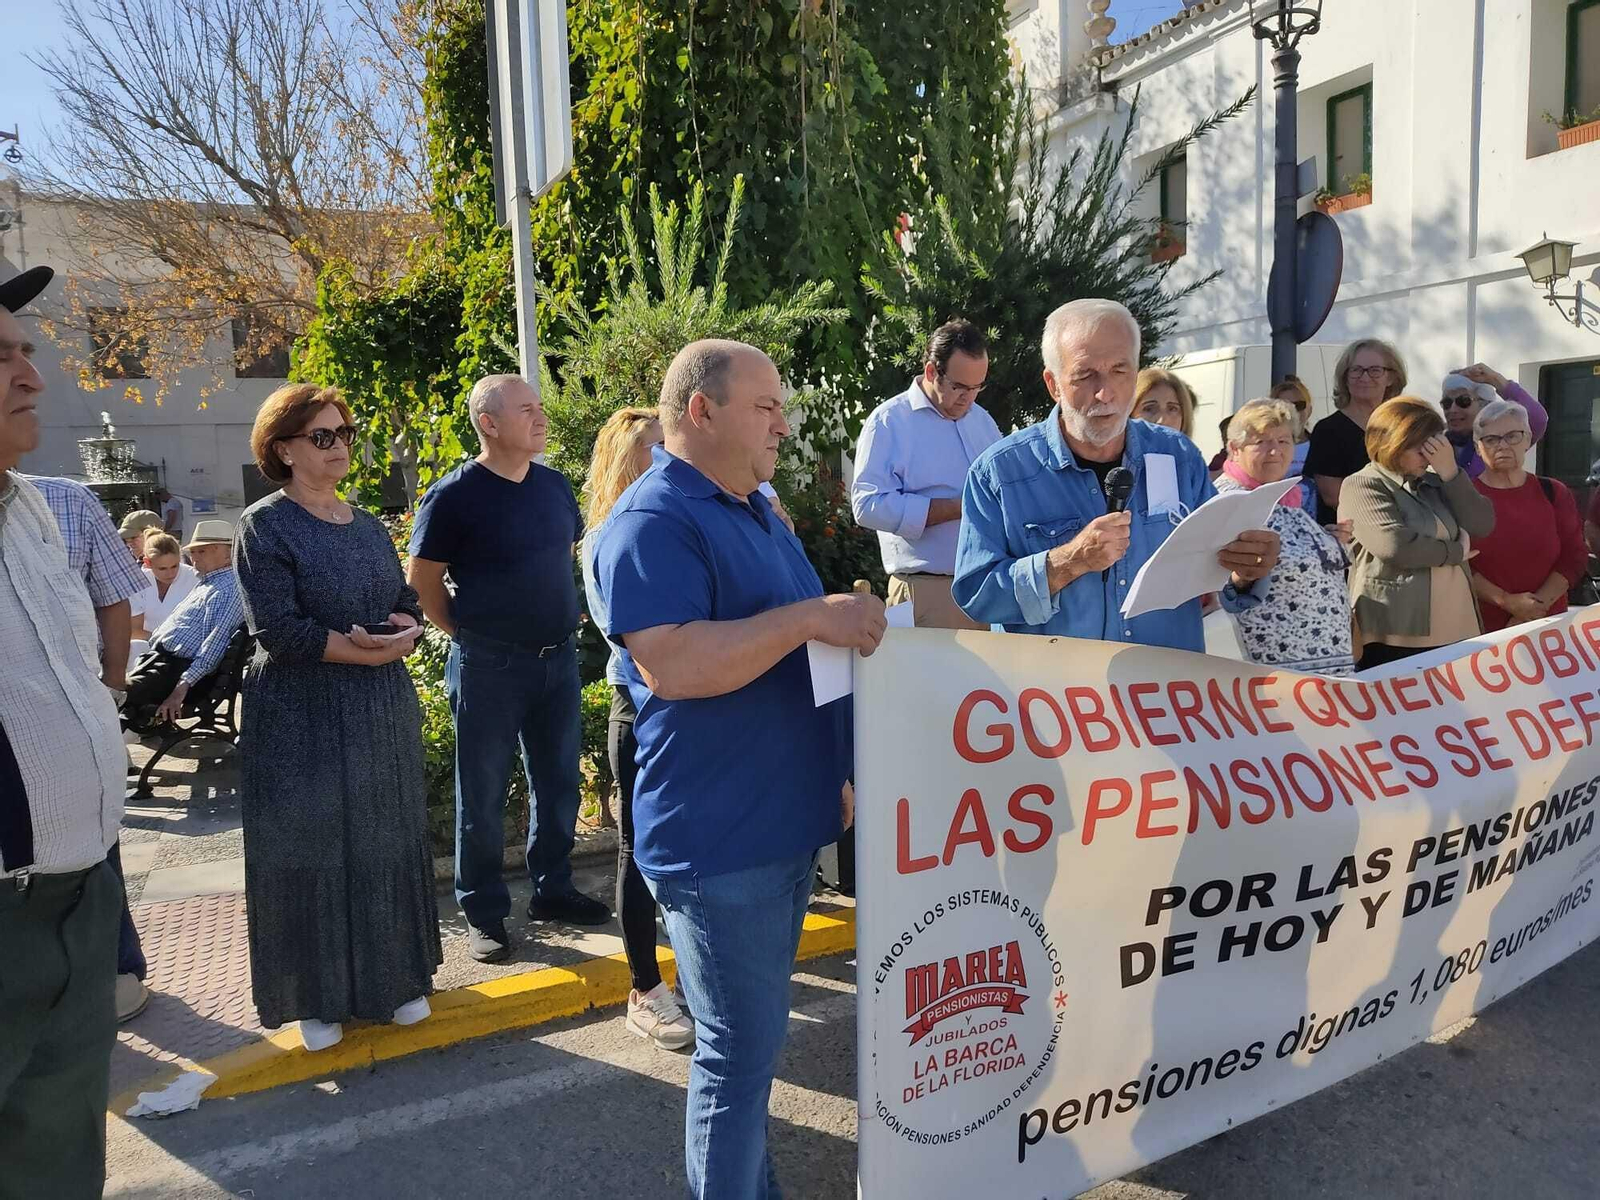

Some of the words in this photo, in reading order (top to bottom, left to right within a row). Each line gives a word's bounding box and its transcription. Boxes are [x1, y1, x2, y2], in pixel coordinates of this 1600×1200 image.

[952, 676, 1295, 764] GOBIERNE
[1293, 661, 1466, 728] QUIEN
[896, 783, 1056, 875] LAS
[1081, 733, 1440, 846] PENSIONES
[1434, 716, 1514, 778] SE
[1505, 689, 1600, 761] DEF
[1119, 931, 1198, 989] DE
[1217, 905, 1342, 963] HOY
[1361, 890, 1392, 931] Y
[1402, 869, 1459, 919] DE
[1465, 809, 1595, 896] MAÑANA
[1144, 871, 1278, 927] POR
[1294, 846, 1394, 901] LAS
[1405, 778, 1600, 874] PENSIONES
[904, 940, 1028, 1020] MAREA
[913, 903, 945, 934] LOS
[947, 889, 1020, 913] SISTEMAS
[1020, 906, 1065, 987] PÚBLICOS
[925, 1016, 1009, 1047] JUBILADOS
[926, 990, 1009, 1022] PENSIONISTAS
[965, 1014, 973, 1025] Y
[1018, 1039, 1265, 1163] pensiones
[1275, 987, 1398, 1060] dignas
[1409, 939, 1487, 1006] 1,080
[1489, 878, 1594, 964] euros/mes
[901, 1126, 961, 1146] PENSIONES
[964, 1097, 1012, 1136] SANIDAD
[1012, 1010, 1066, 1100] DEPENDENCIA
[902, 1081, 926, 1104] DE
[929, 1073, 949, 1093] LA
[953, 1052, 1026, 1085] FLORIDA
[913, 1054, 939, 1080] LA
[944, 1033, 1018, 1068] BARCA
